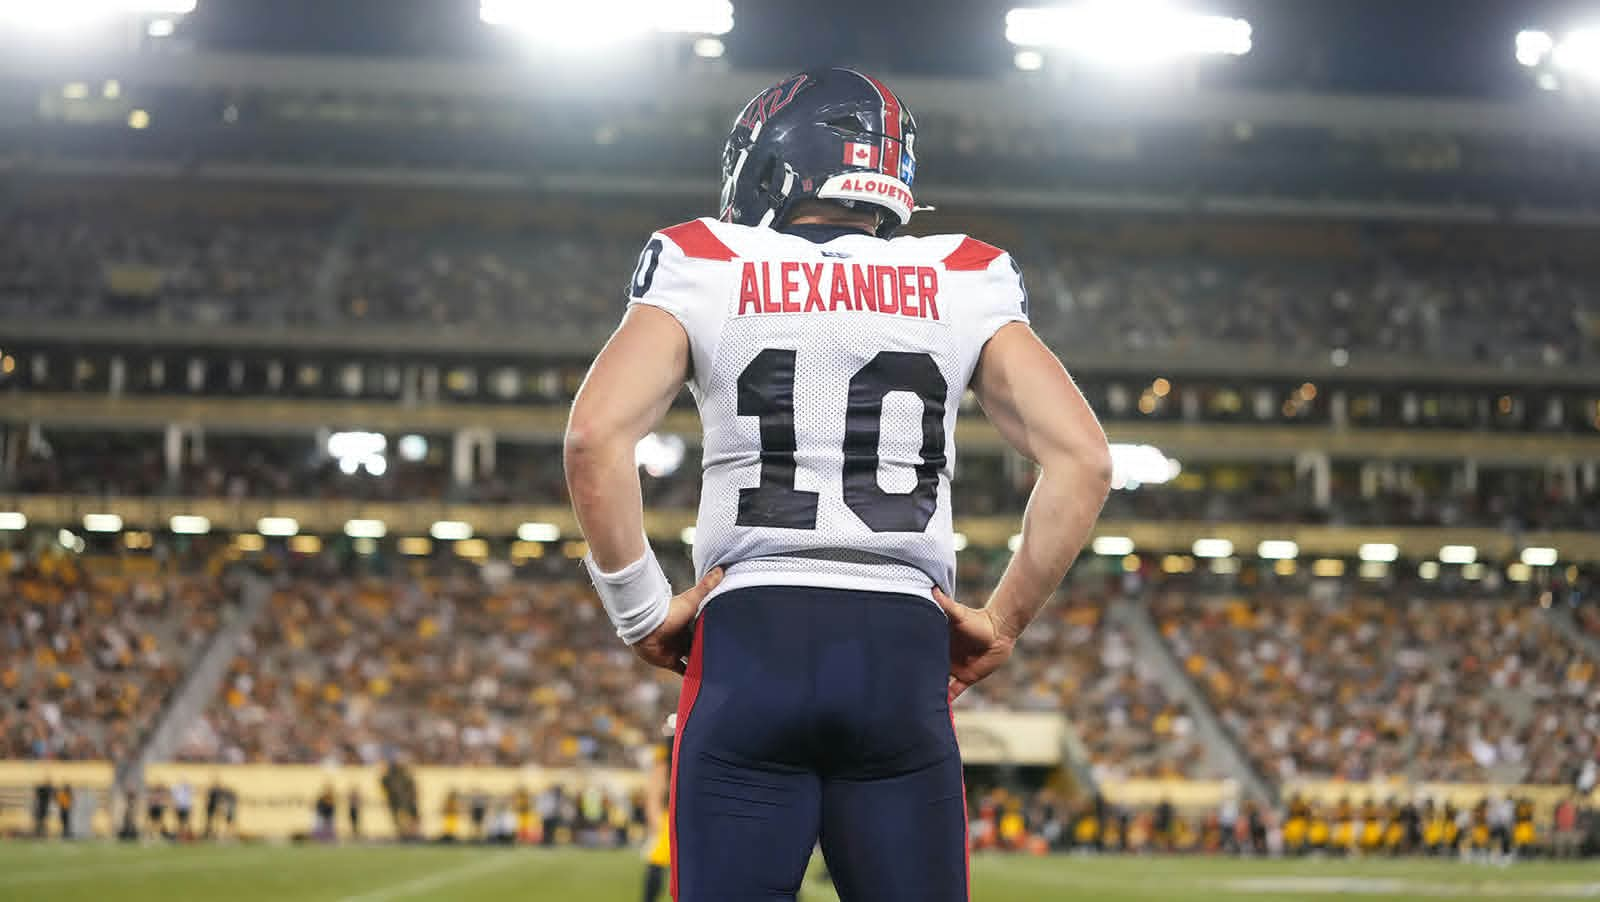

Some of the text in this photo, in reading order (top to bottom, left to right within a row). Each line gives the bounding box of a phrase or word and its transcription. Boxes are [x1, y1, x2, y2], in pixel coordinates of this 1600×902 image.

[841, 178, 915, 211] ALOUETTE
[738, 261, 940, 320] ALEXANDER
[735, 348, 948, 533] 10
